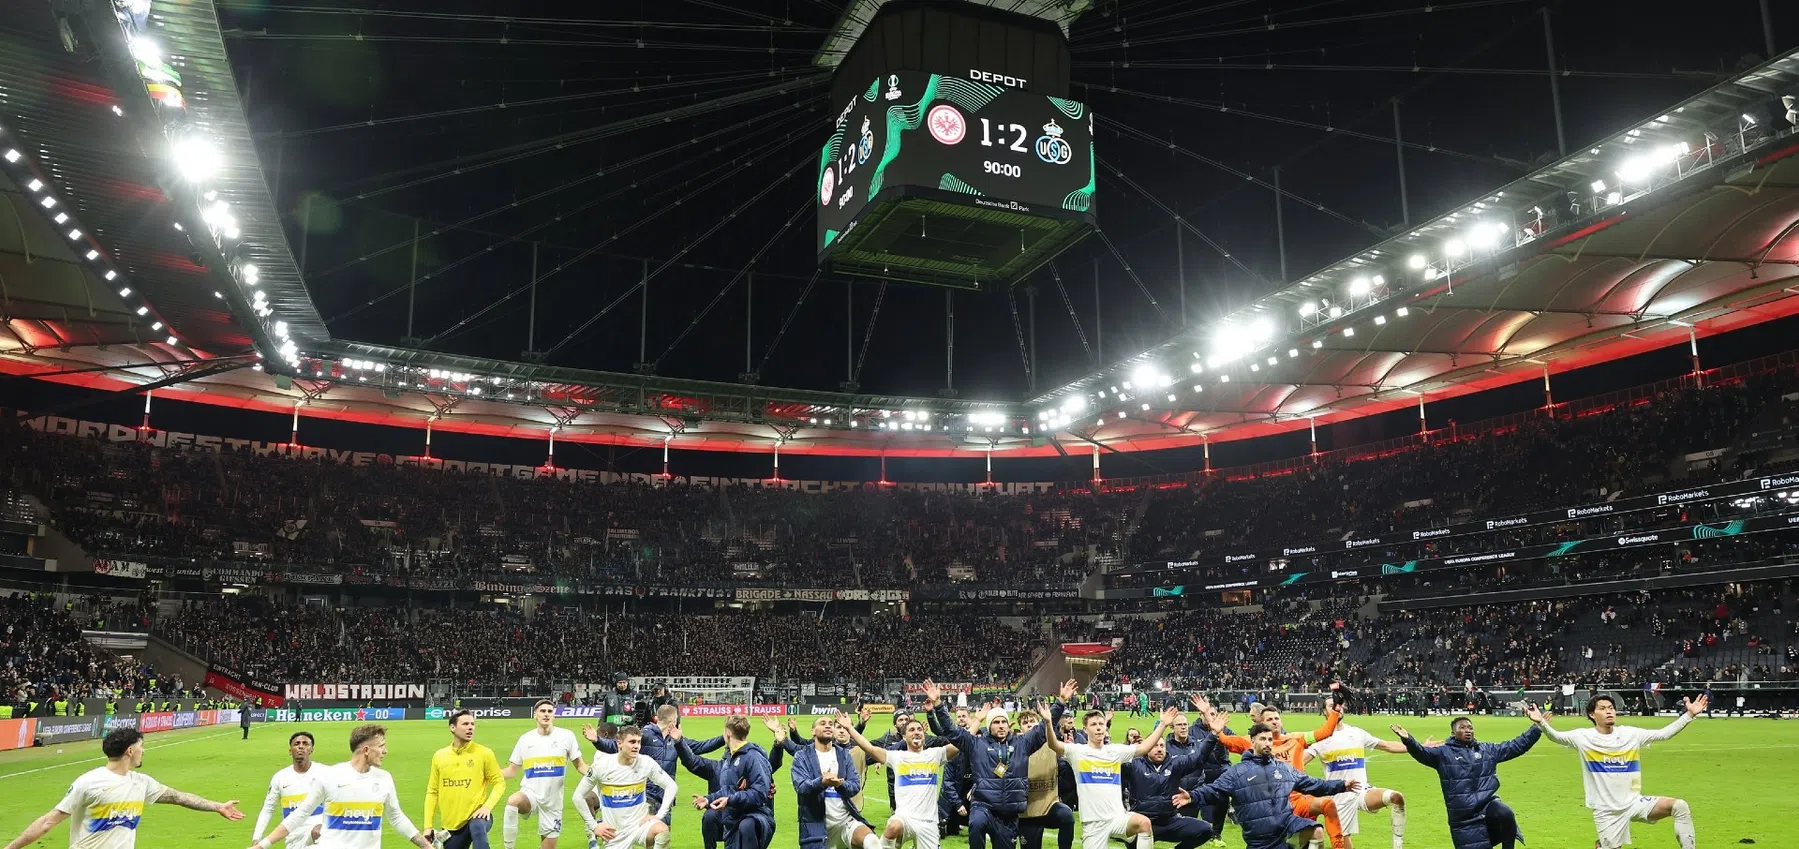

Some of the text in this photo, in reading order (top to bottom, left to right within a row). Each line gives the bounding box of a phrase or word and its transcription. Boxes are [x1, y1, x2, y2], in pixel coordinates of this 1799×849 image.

[970, 69, 1027, 89] DEPOT
[836, 94, 858, 128] DEPOT
[980, 118, 1028, 153] 1:2
[838, 143, 856, 185] 1:2
[983, 160, 1021, 178] 90:00
[975, 198, 998, 207] Deutsche
[1668, 490, 1709, 502] RoboMarkets
[1576, 505, 1613, 516] RoboMarkets
[1494, 517, 1528, 527] RoboMarkets
[1420, 528, 1450, 537] RoboMarkets
[1352, 538, 1380, 547] RoboMarkets
[1625, 534, 1659, 544] Swissquote
[1498, 551, 1516, 559] LEAGUE
[176, 568, 200, 576] united
[212, 567, 264, 577] COMMANDO
[219, 575, 257, 584] GIESSEN
[473, 580, 524, 593] Binding
[578, 585, 633, 596] ULTRAS
[736, 589, 833, 600] BRIGADE NASSAU
[213, 663, 279, 693] EINTRACHT FAN-CLUB
[285, 683, 424, 700] WALDSTADION
[693, 704, 782, 715] STRAUSS STRAUSS
[811, 703, 838, 715] bwin
[1275, 749, 1290, 761] ey!
[1603, 755, 1628, 765] hey!
[1091, 765, 1114, 776] hey!
[442, 778, 472, 789] Ebury
[1030, 781, 1055, 790] ESPECT
[108, 807, 138, 820] hey!
[343, 807, 374, 821] hey!
